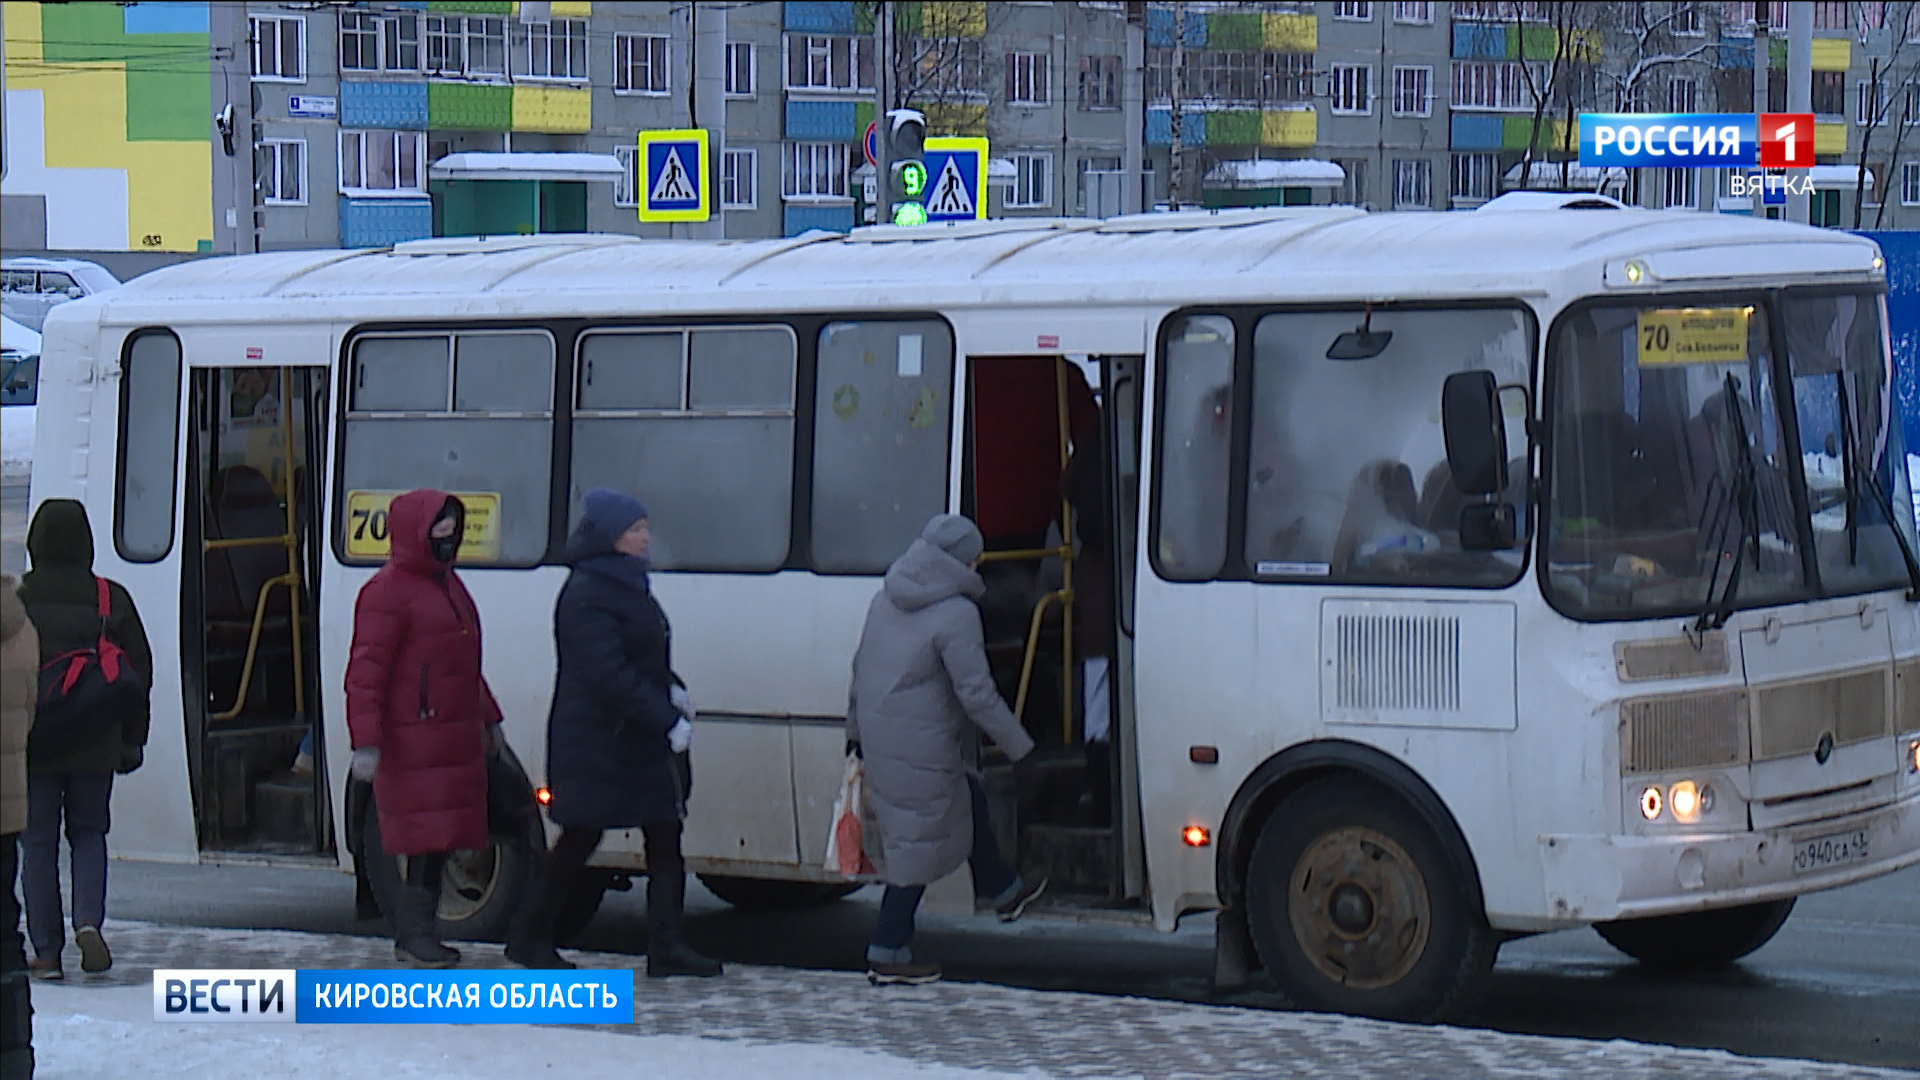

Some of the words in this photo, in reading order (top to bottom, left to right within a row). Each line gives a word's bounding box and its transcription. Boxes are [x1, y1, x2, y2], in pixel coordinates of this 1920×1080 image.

[904, 166, 918, 195] 9
[1643, 325, 1670, 351] 70
[352, 508, 389, 541] 70
